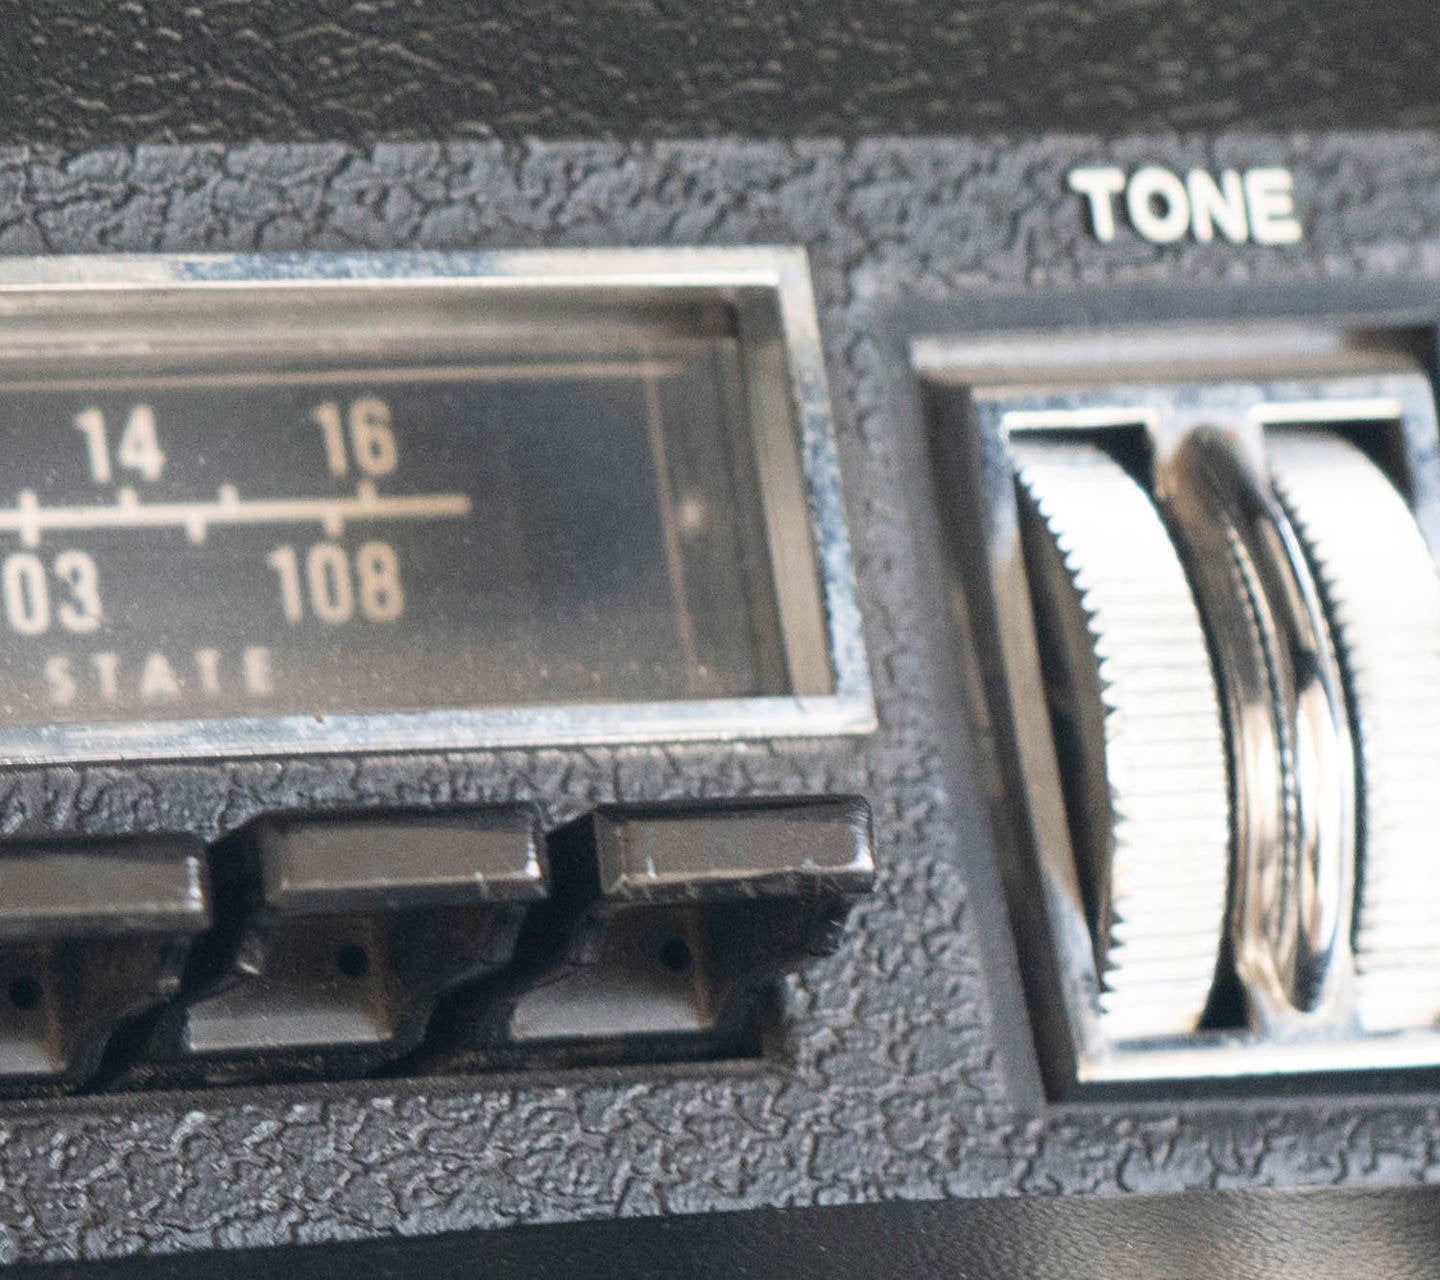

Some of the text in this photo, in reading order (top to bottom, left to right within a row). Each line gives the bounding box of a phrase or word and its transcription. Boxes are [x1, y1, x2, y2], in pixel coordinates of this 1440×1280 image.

[1068, 166, 1304, 246] TONE
[75, 404, 166, 483] 14
[312, 398, 396, 475] 16
[267, 542, 404, 624] 108
[45, 646, 274, 704] STATE
